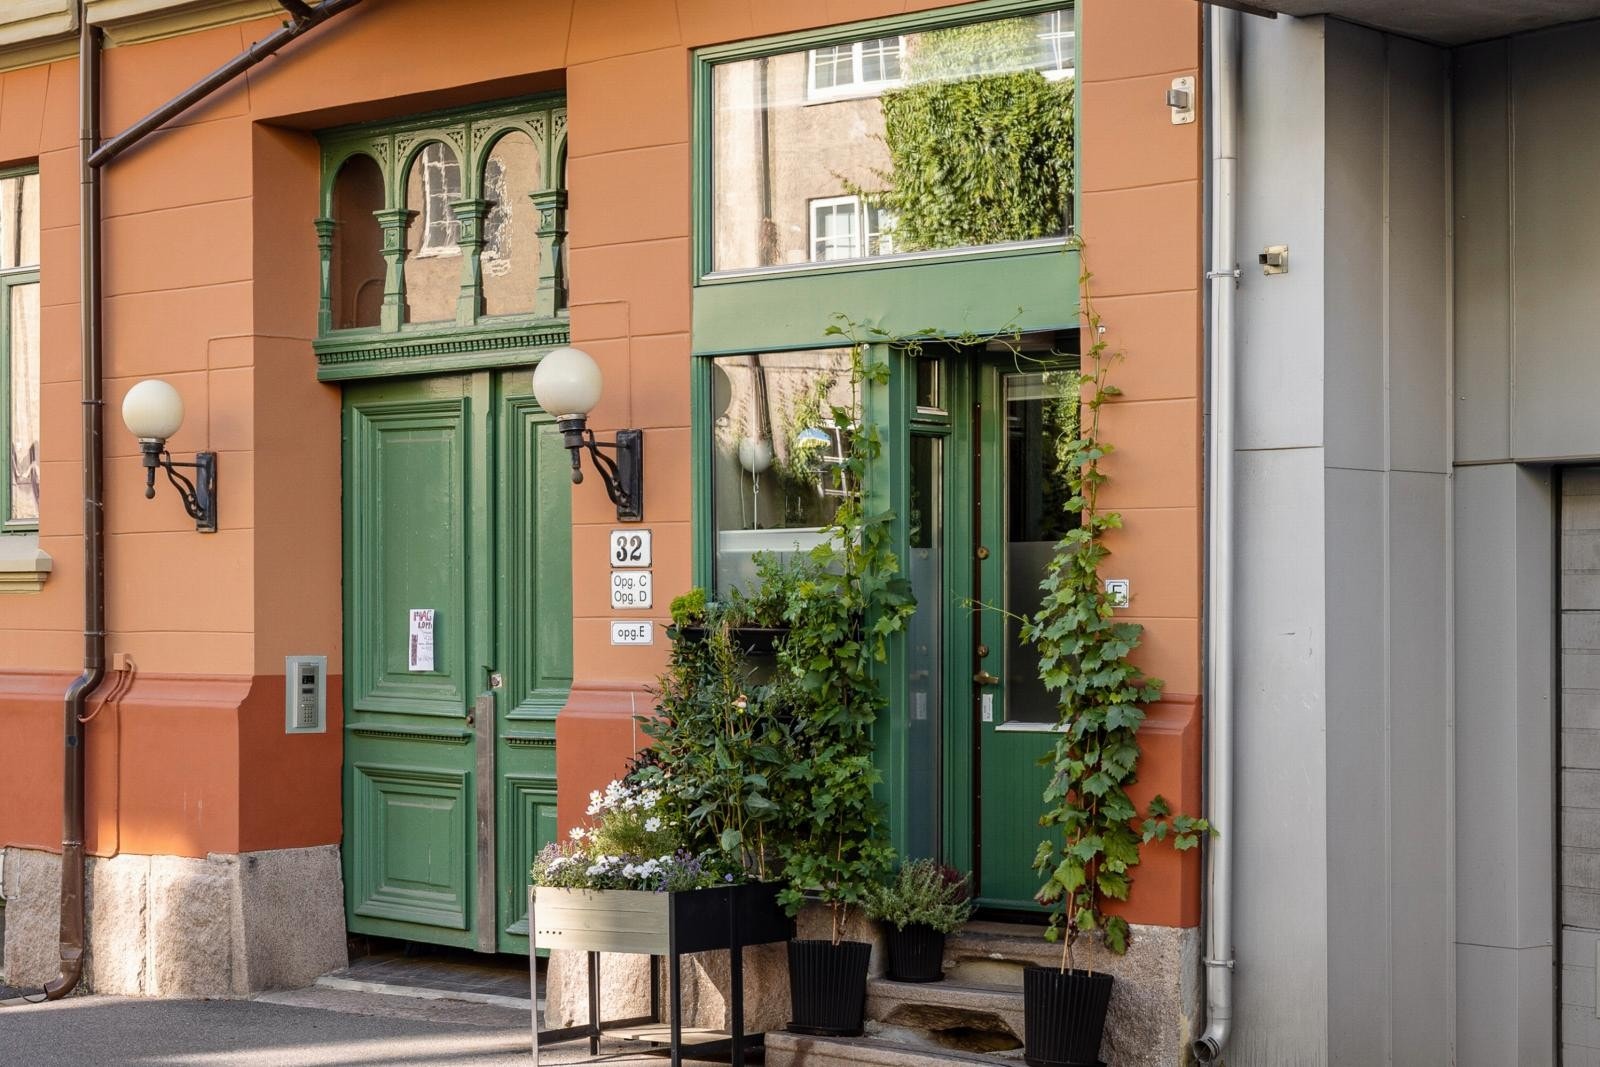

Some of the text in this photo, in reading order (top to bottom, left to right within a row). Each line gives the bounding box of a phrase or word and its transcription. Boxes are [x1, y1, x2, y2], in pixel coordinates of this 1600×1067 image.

[616, 535, 642, 562] 32
[613, 575, 647, 589] Opg. C
[614, 590, 647, 605] Opg. D
